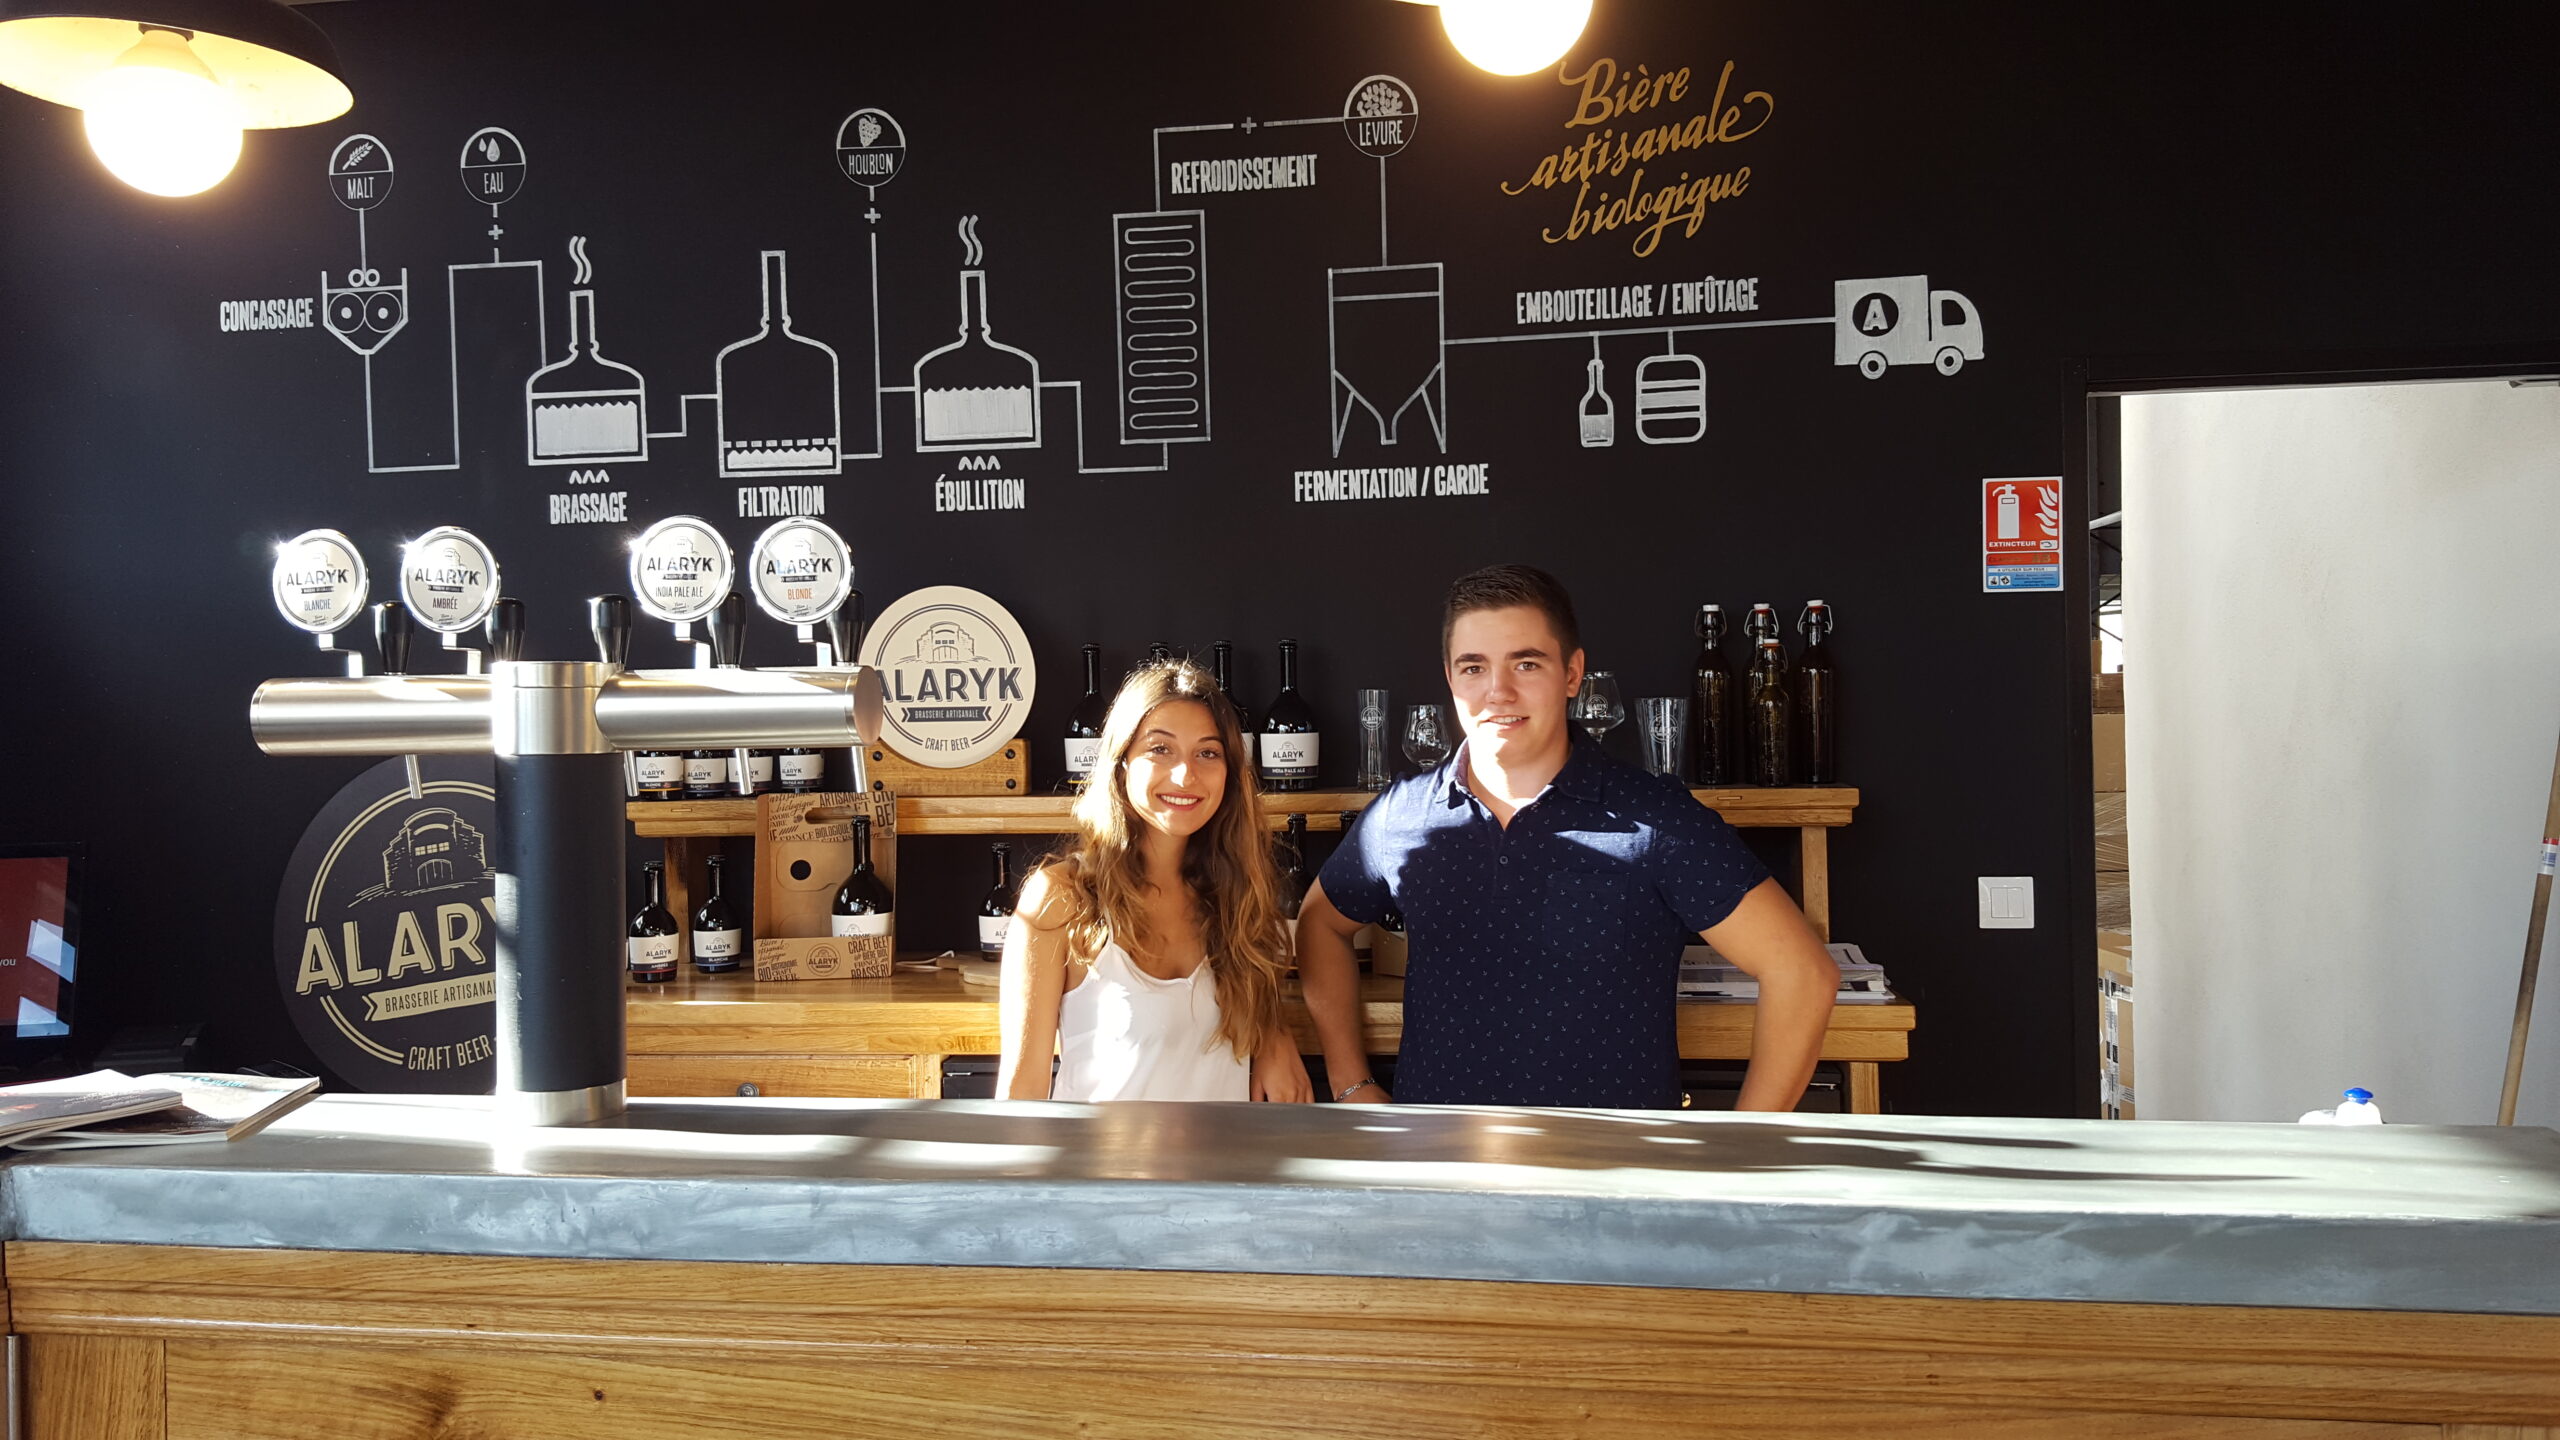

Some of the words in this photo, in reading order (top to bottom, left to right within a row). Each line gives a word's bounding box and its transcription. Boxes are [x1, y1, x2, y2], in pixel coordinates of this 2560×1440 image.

[1559, 57, 1690, 130] Bière
[1359, 119, 1404, 147] LEVURE
[1501, 60, 1774, 196] artisanale
[848, 151, 894, 176] HOUBLON
[1171, 154, 1318, 194] REFROIDISSEMENT
[347, 176, 375, 200] MALT
[483, 171, 505, 195] EAU
[1542, 165, 1751, 258] biologique
[1516, 284, 1653, 325] EMBOUTEILLAGE
[1672, 275, 1759, 315] ENFÛTAGE
[219, 298, 314, 332] CONCASSAGE
[1863, 298, 1889, 331] A
[935, 474, 1025, 513] ÉBULLITION
[1294, 466, 1417, 502] FERMENTATION
[1434, 463, 1489, 496] GARDE
[549, 491, 628, 524] BRASSAGE
[737, 485, 825, 518] FILTRATION
[647, 557, 714, 571] ALARYK
[766, 558, 833, 574] ALARYK
[287, 569, 349, 586] ALARYK
[415, 568, 481, 586] ALARYK
[433, 596, 458, 609] AMBRÉE
[674, 586, 690, 597] PALE
[692, 586, 703, 597] ALE
[788, 588, 813, 600] BLONDE
[304, 599, 332, 611] BLANCHE
[914, 709, 944, 719] BRASSERIE
[946, 708, 979, 718] ARTISANALE
[925, 737, 948, 751] CRAFT
[951, 737, 970, 750] BEER
[1272, 750, 1304, 758] ALARYK
[1074, 755, 1100, 763] ALARY
[296, 896, 496, 996] ALAR
[646, 948, 672, 957] ALARYK
[848, 938, 872, 954] CRAFT
[808, 956, 838, 966] ALARYK
[758, 966, 772, 981] BIO
[385, 991, 440, 1014] BRASSERIE
[408, 1045, 451, 1071] CRAFT
[456, 1034, 493, 1067] BEER
